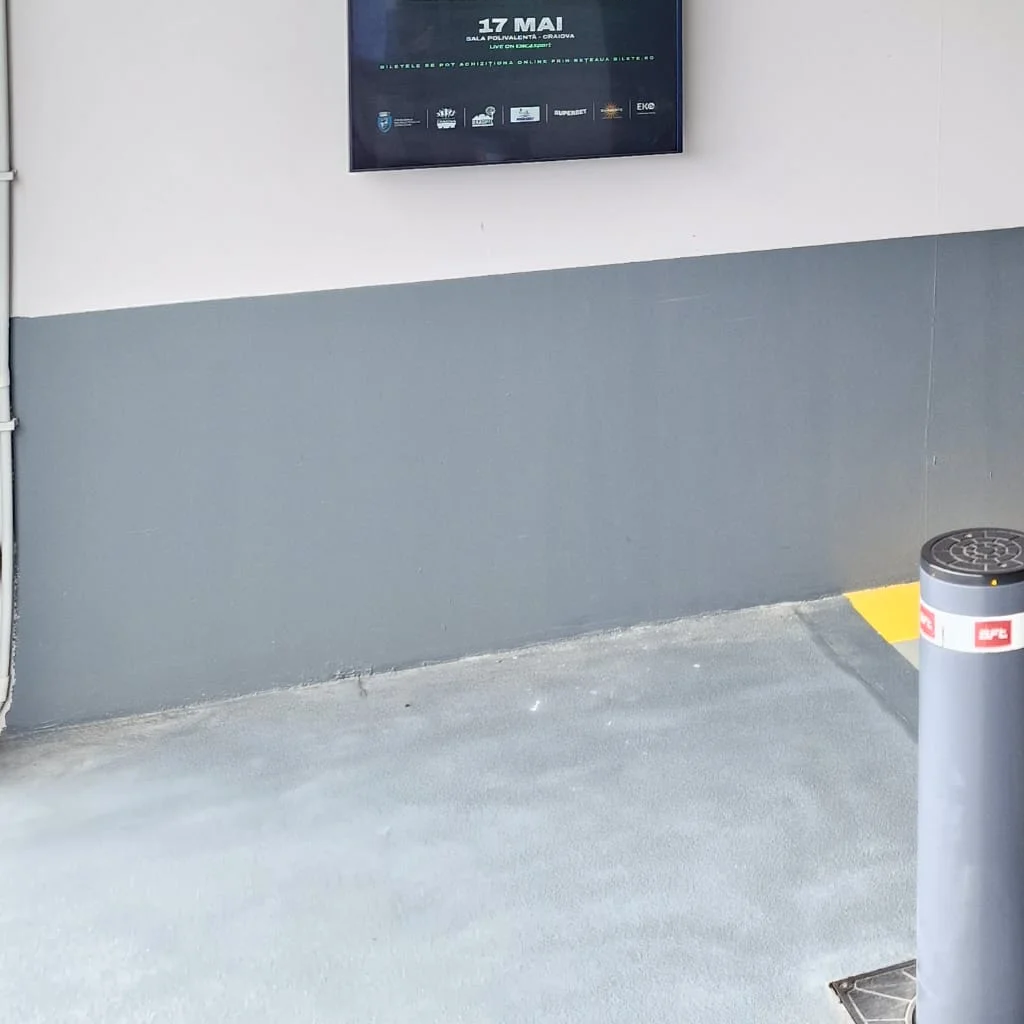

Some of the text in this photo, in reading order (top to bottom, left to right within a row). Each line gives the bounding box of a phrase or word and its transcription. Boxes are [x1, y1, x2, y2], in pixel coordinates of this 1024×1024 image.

[478, 16, 563, 34] 17 MAI
[636, 102, 656, 111] EKO
